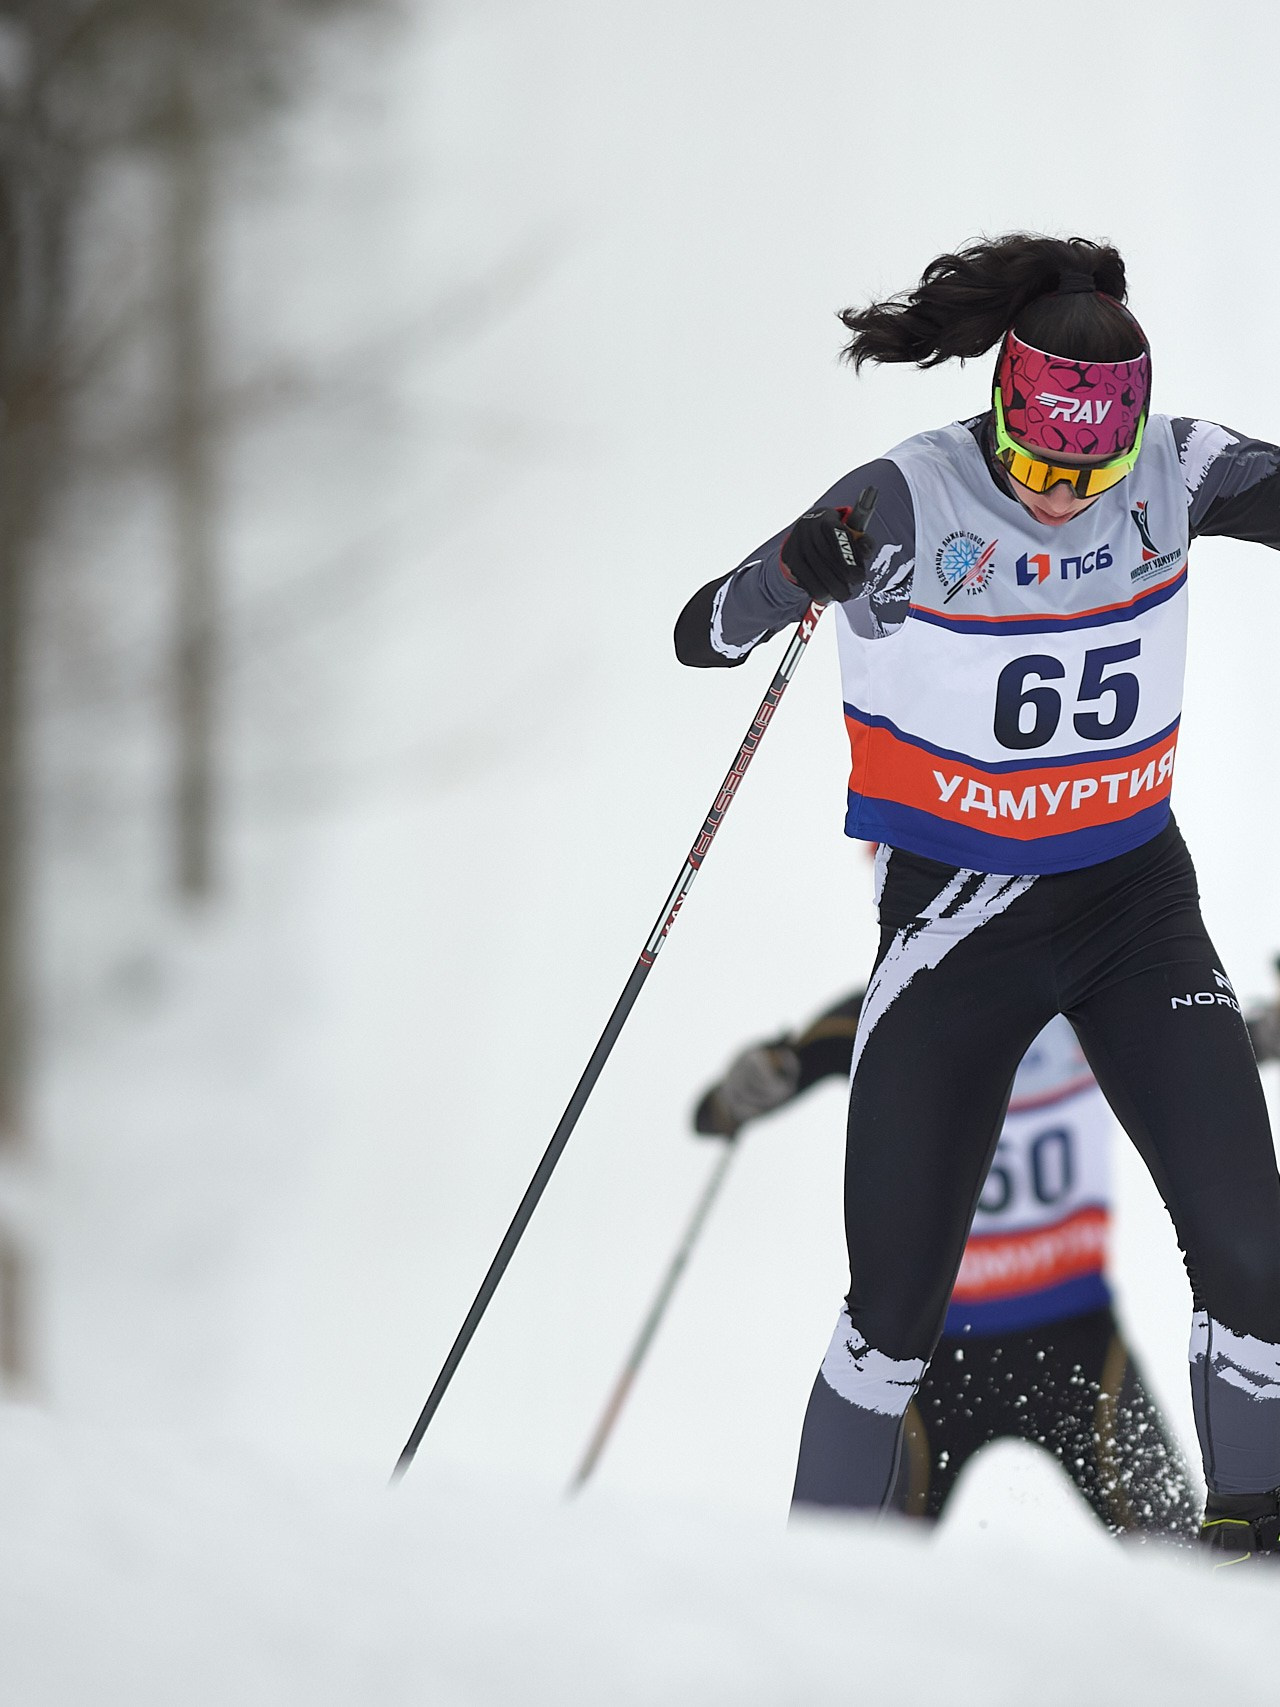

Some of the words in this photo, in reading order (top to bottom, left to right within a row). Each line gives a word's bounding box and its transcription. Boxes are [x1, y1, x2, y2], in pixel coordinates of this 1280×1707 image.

[1035, 392, 1113, 425] RAY
[834, 528, 857, 566] KV+
[942, 530, 966, 547] ЛЫЖНЫ
[1060, 543, 1114, 580] ПСБ
[992, 638, 1142, 750] 65
[932, 746, 1174, 821] УДМУРТИЯ
